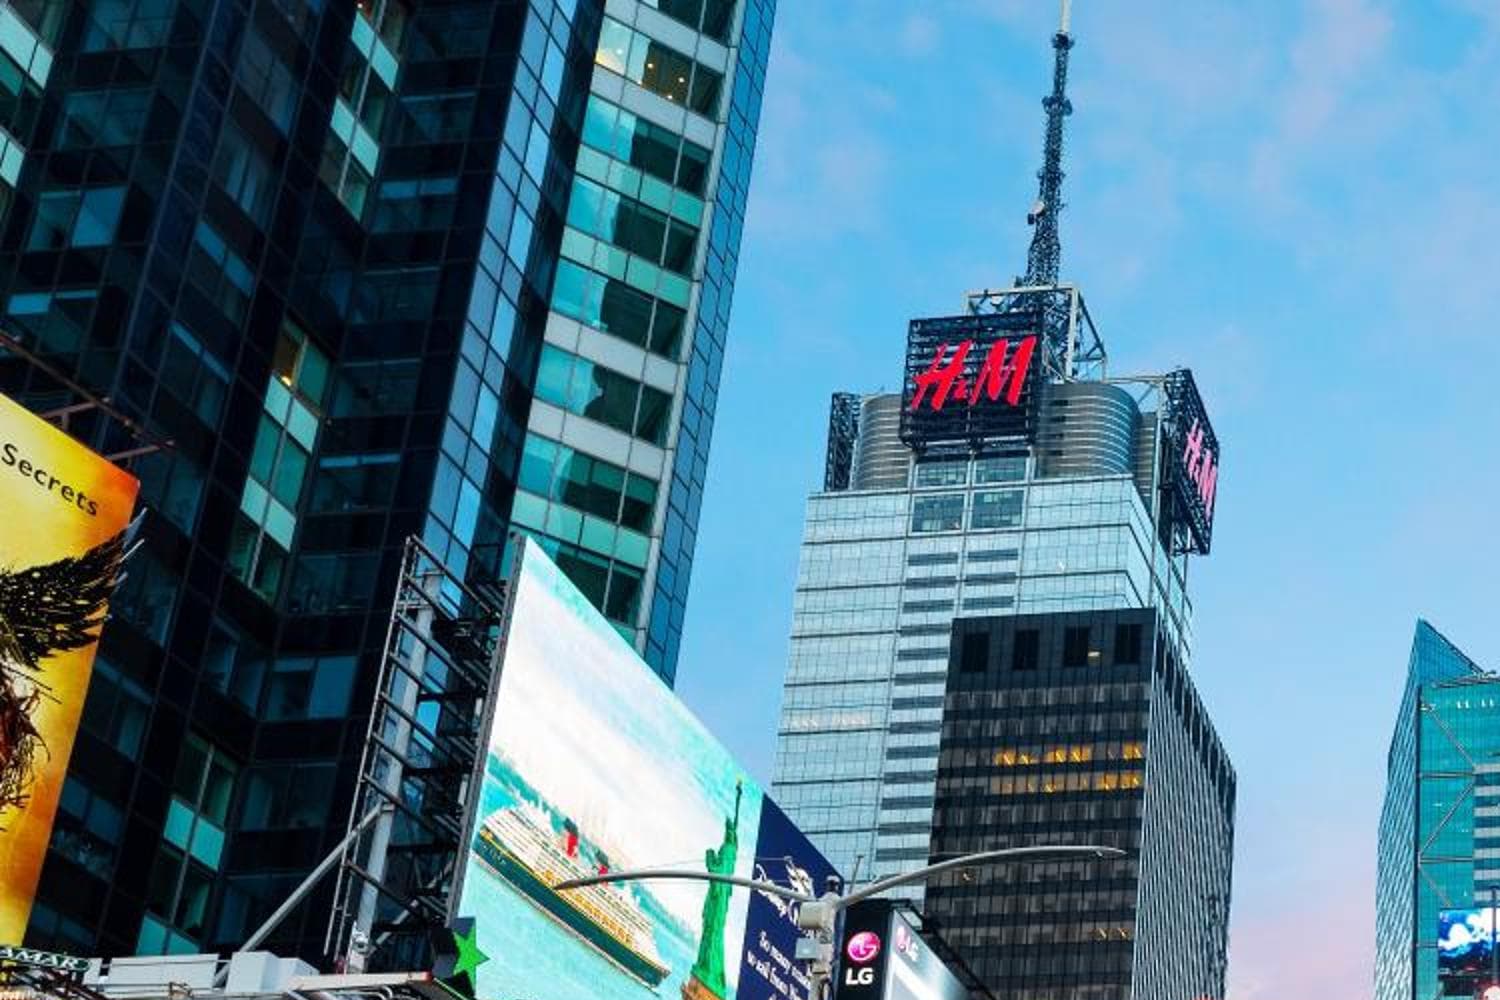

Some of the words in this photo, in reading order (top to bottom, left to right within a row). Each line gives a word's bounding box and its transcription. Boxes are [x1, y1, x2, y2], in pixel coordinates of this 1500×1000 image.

[911, 336, 1036, 411] H&M
[1, 443, 99, 517] Secrets
[846, 968, 873, 985] LG
